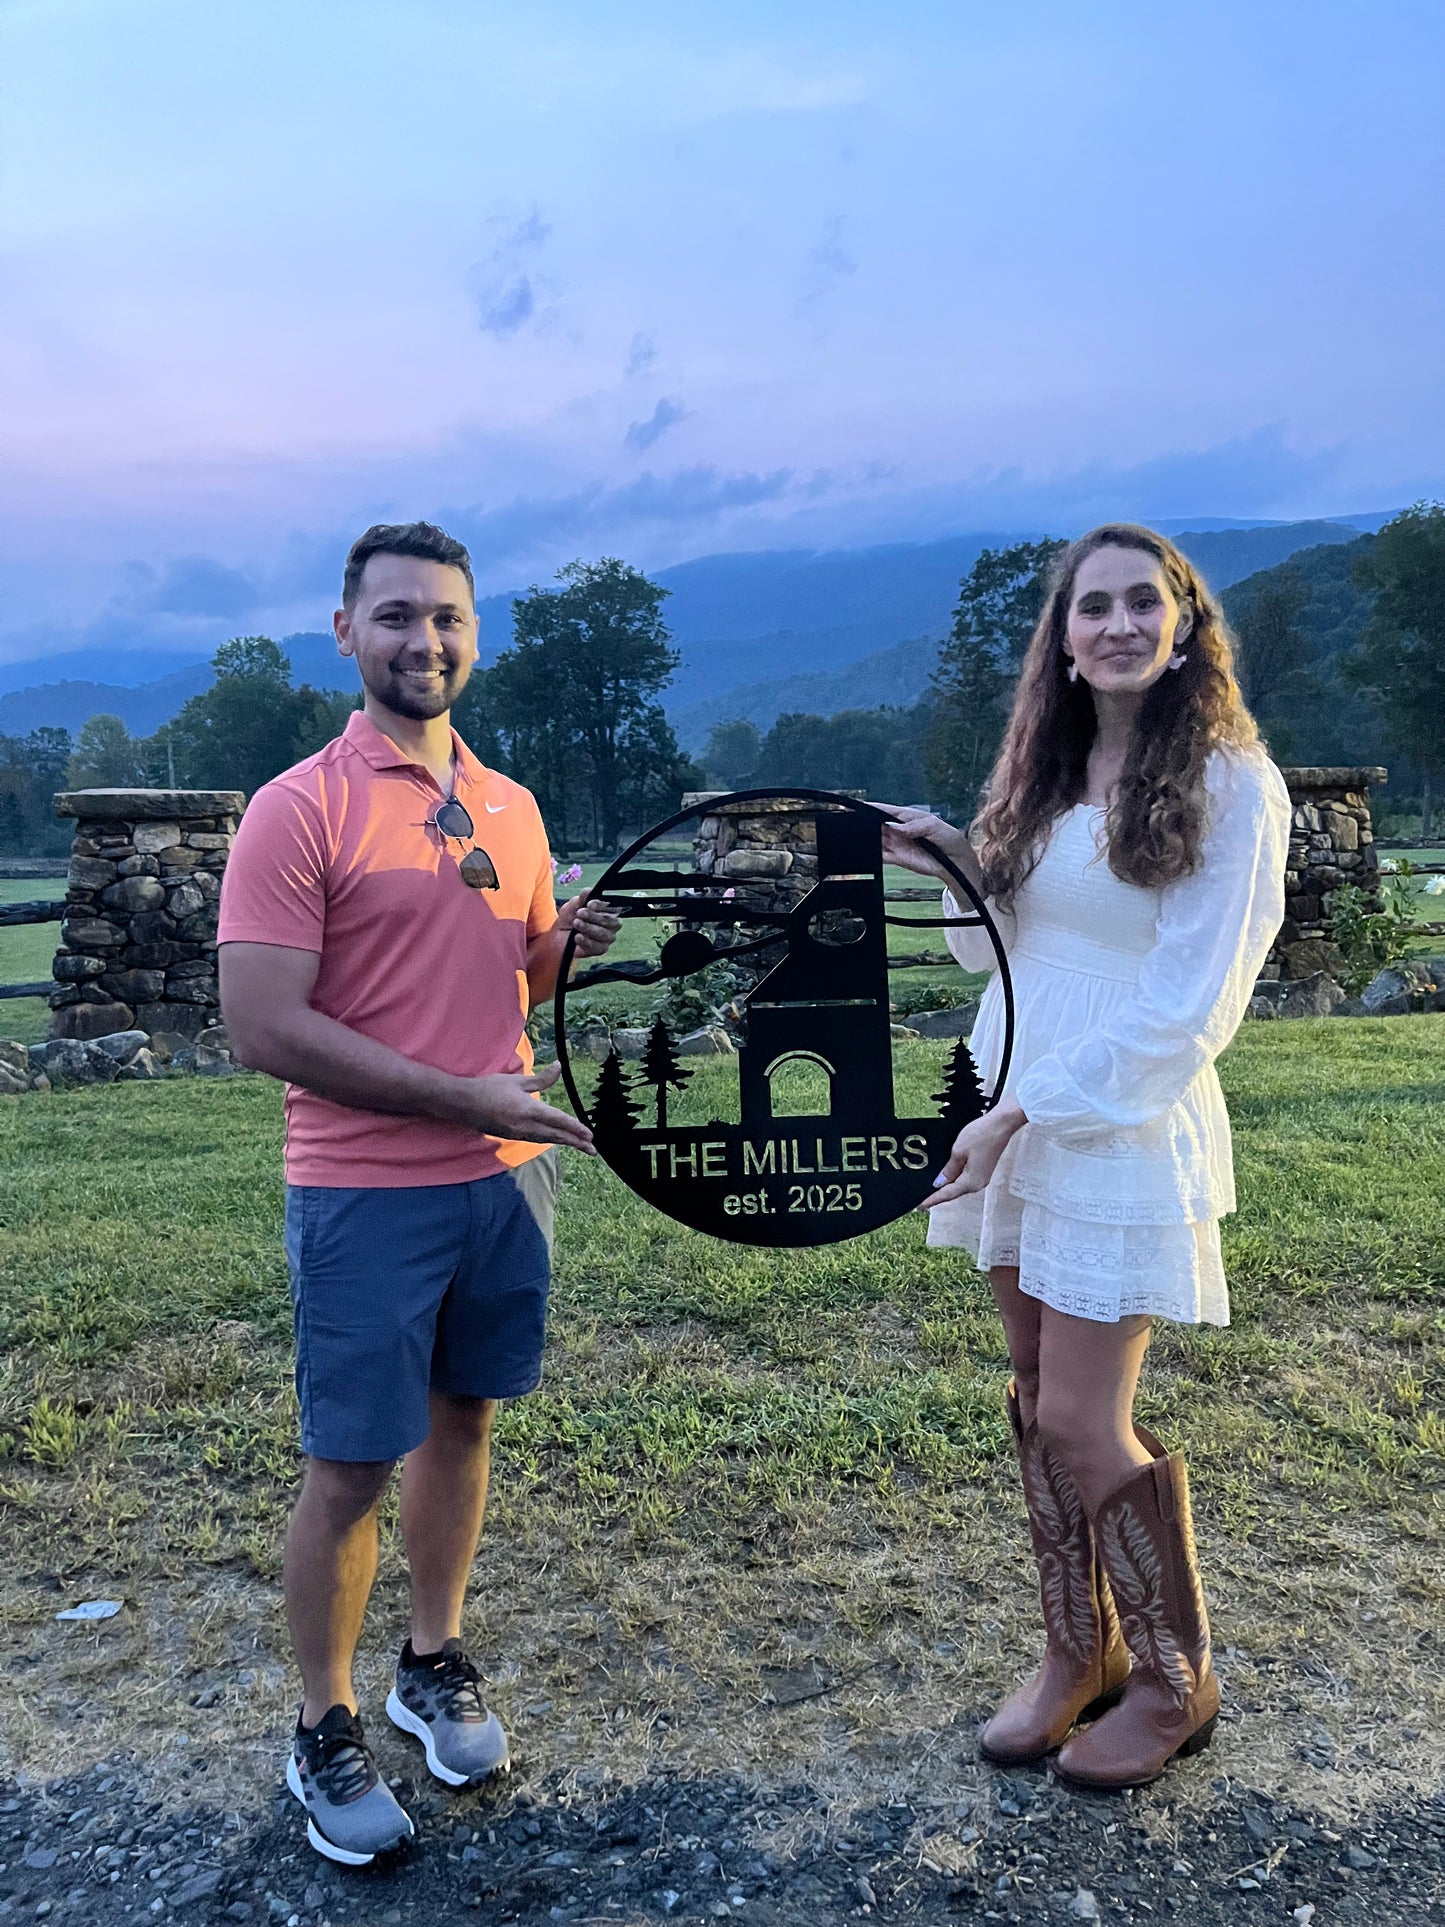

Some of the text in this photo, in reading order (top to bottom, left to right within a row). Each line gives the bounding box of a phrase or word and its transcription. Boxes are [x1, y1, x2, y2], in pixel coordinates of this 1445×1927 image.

[641, 1135, 928, 1178] THE MILLERS
[724, 1184, 862, 1215] est. 2025
